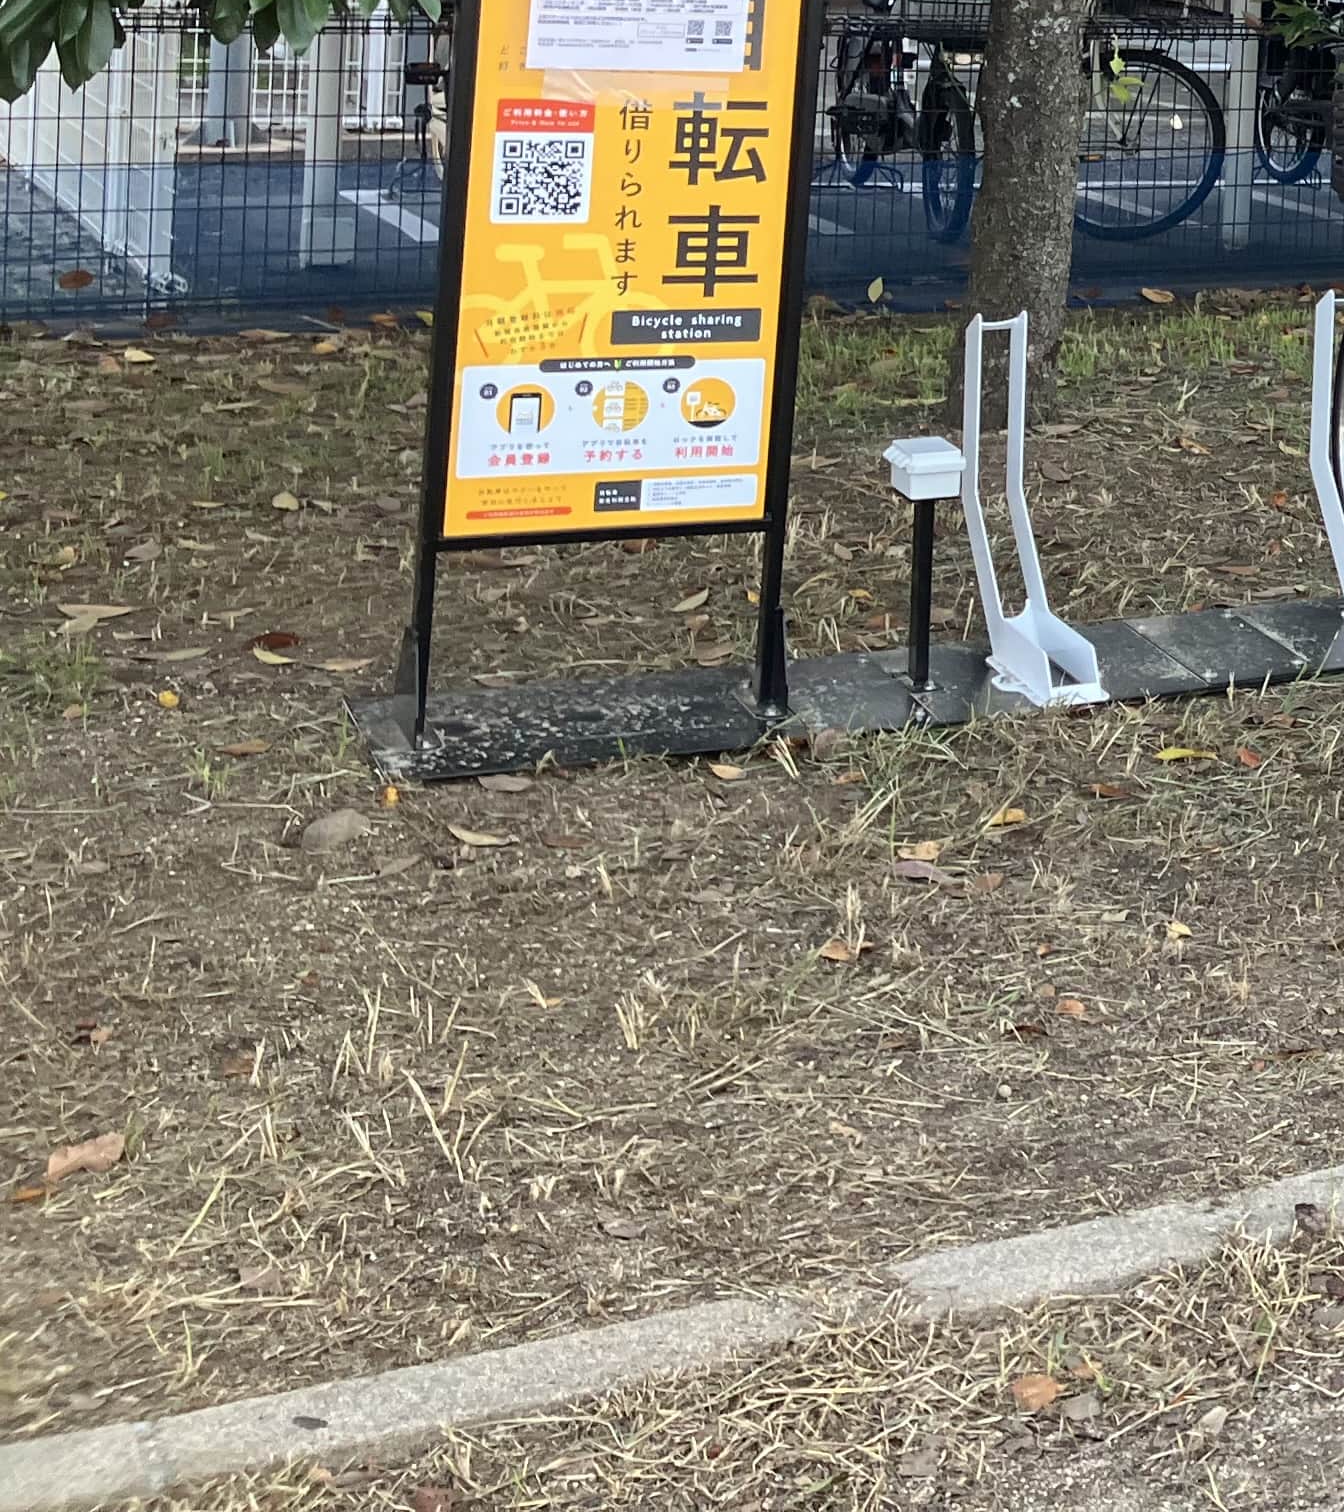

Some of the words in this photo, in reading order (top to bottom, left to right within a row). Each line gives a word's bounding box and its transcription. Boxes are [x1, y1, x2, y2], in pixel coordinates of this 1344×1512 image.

[611, 99, 654, 297] 借りられます
[631, 314, 683, 328] Bicycle
[691, 315, 743, 327] sharing
[661, 328, 712, 339] station
[583, 448, 643, 463] 予約する
